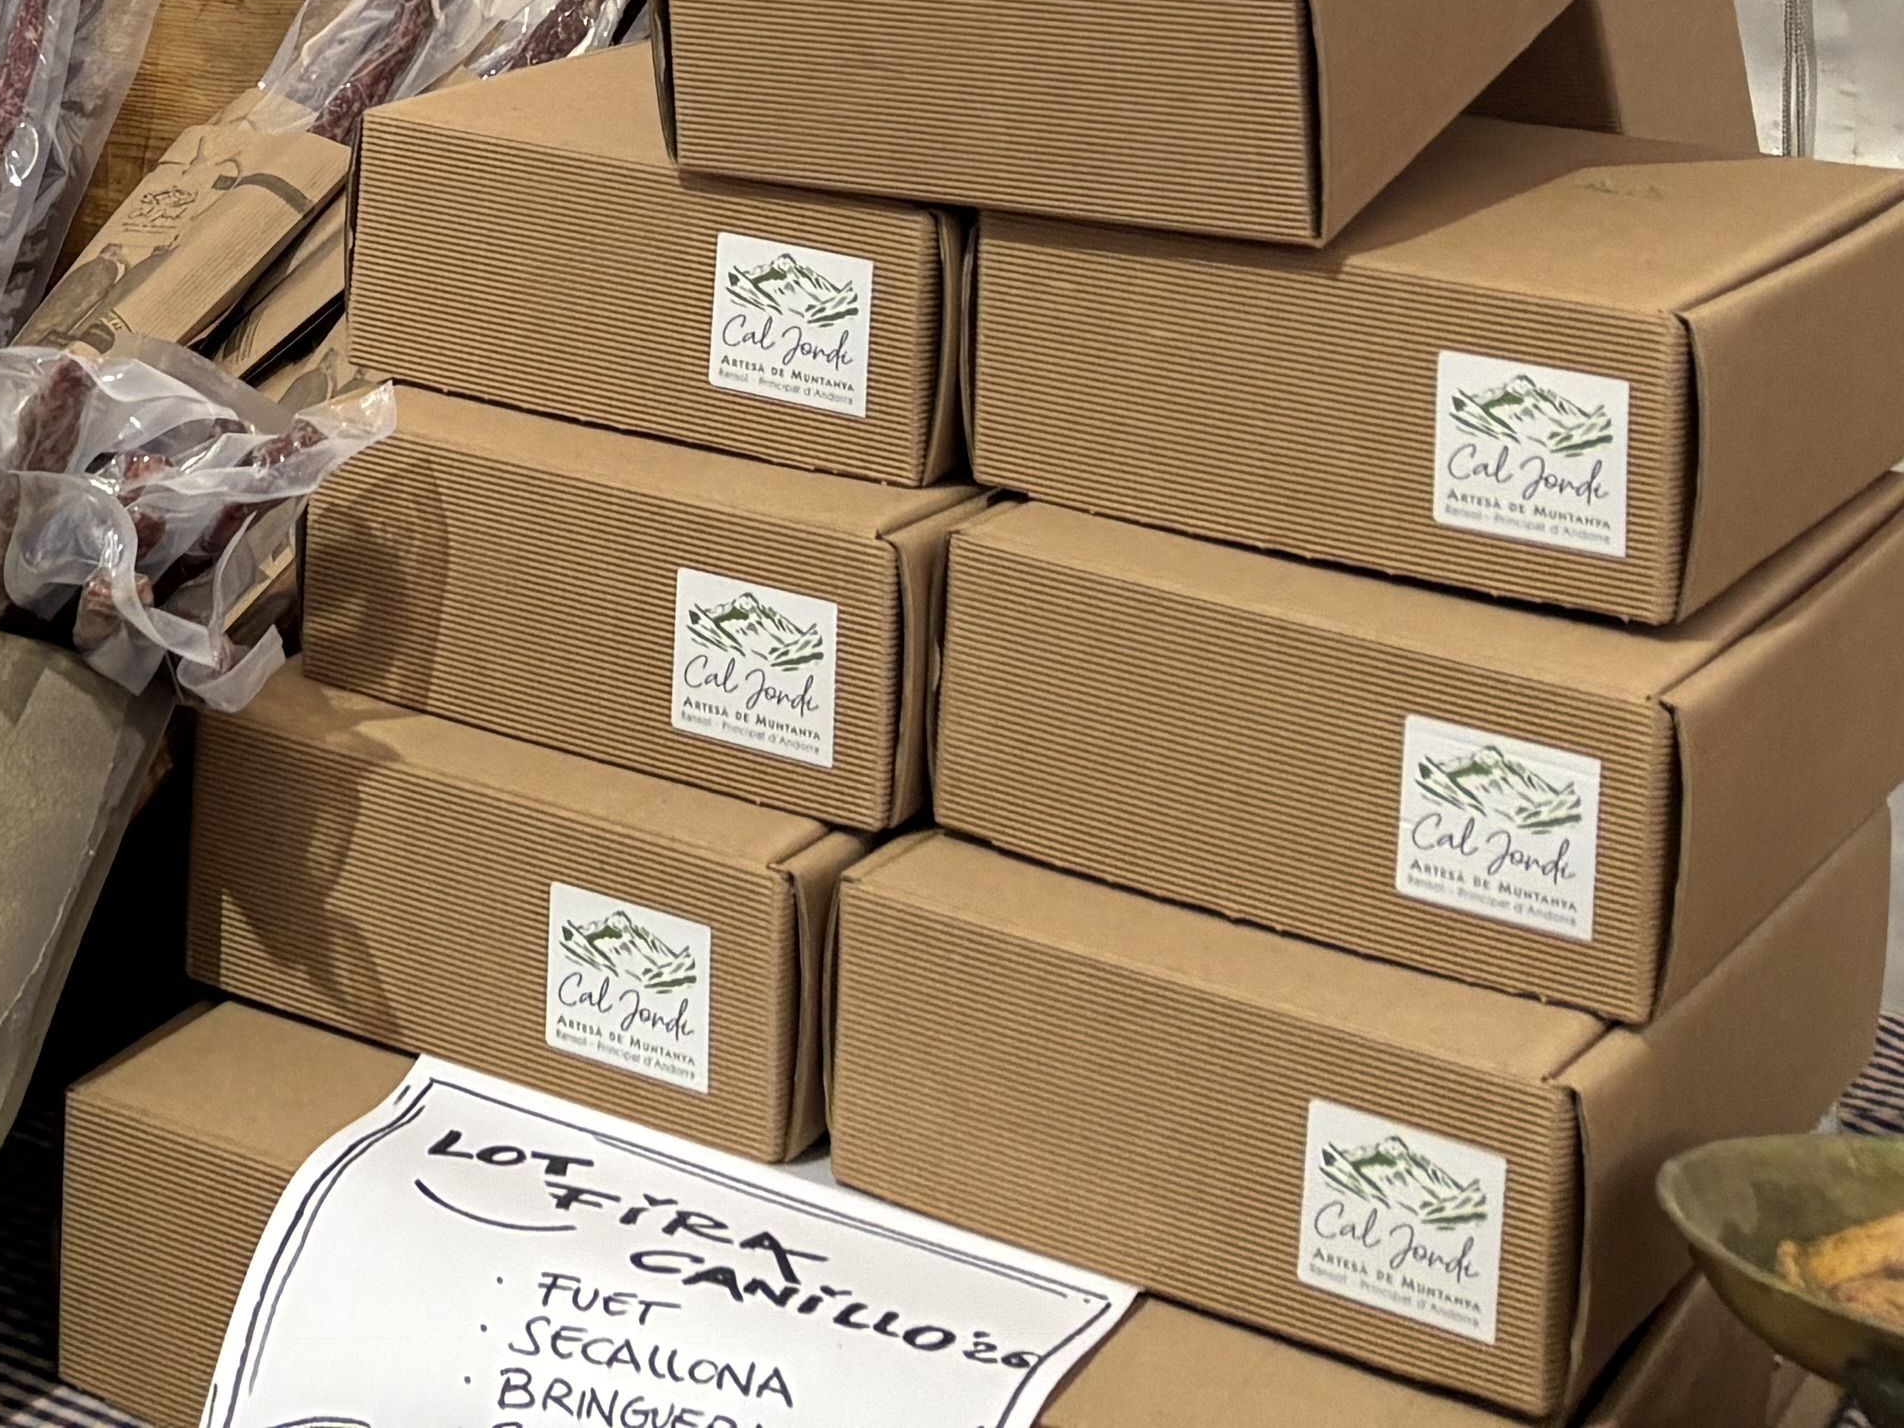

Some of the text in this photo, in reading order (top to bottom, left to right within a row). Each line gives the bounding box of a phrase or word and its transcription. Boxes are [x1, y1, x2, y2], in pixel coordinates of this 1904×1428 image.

[722, 314, 854, 371] Cal Jordi
[1447, 443, 1609, 505] Cal Jordi
[684, 654, 819, 718] Cal Jordi
[1412, 812, 1576, 885] Cal Jordi
[558, 972, 694, 1042] Cal Jordi
[427, 1129, 595, 1176] LOT
[545, 1180, 829, 1285] FIRA
[1314, 1200, 1480, 1284] Cal Jordi
[539, 1271, 681, 1325] FUET
[629, 1250, 957, 1351] CANILLO
[508, 1315, 794, 1408] SECALLONA
[497, 1367, 765, 1428] BRINGUE
